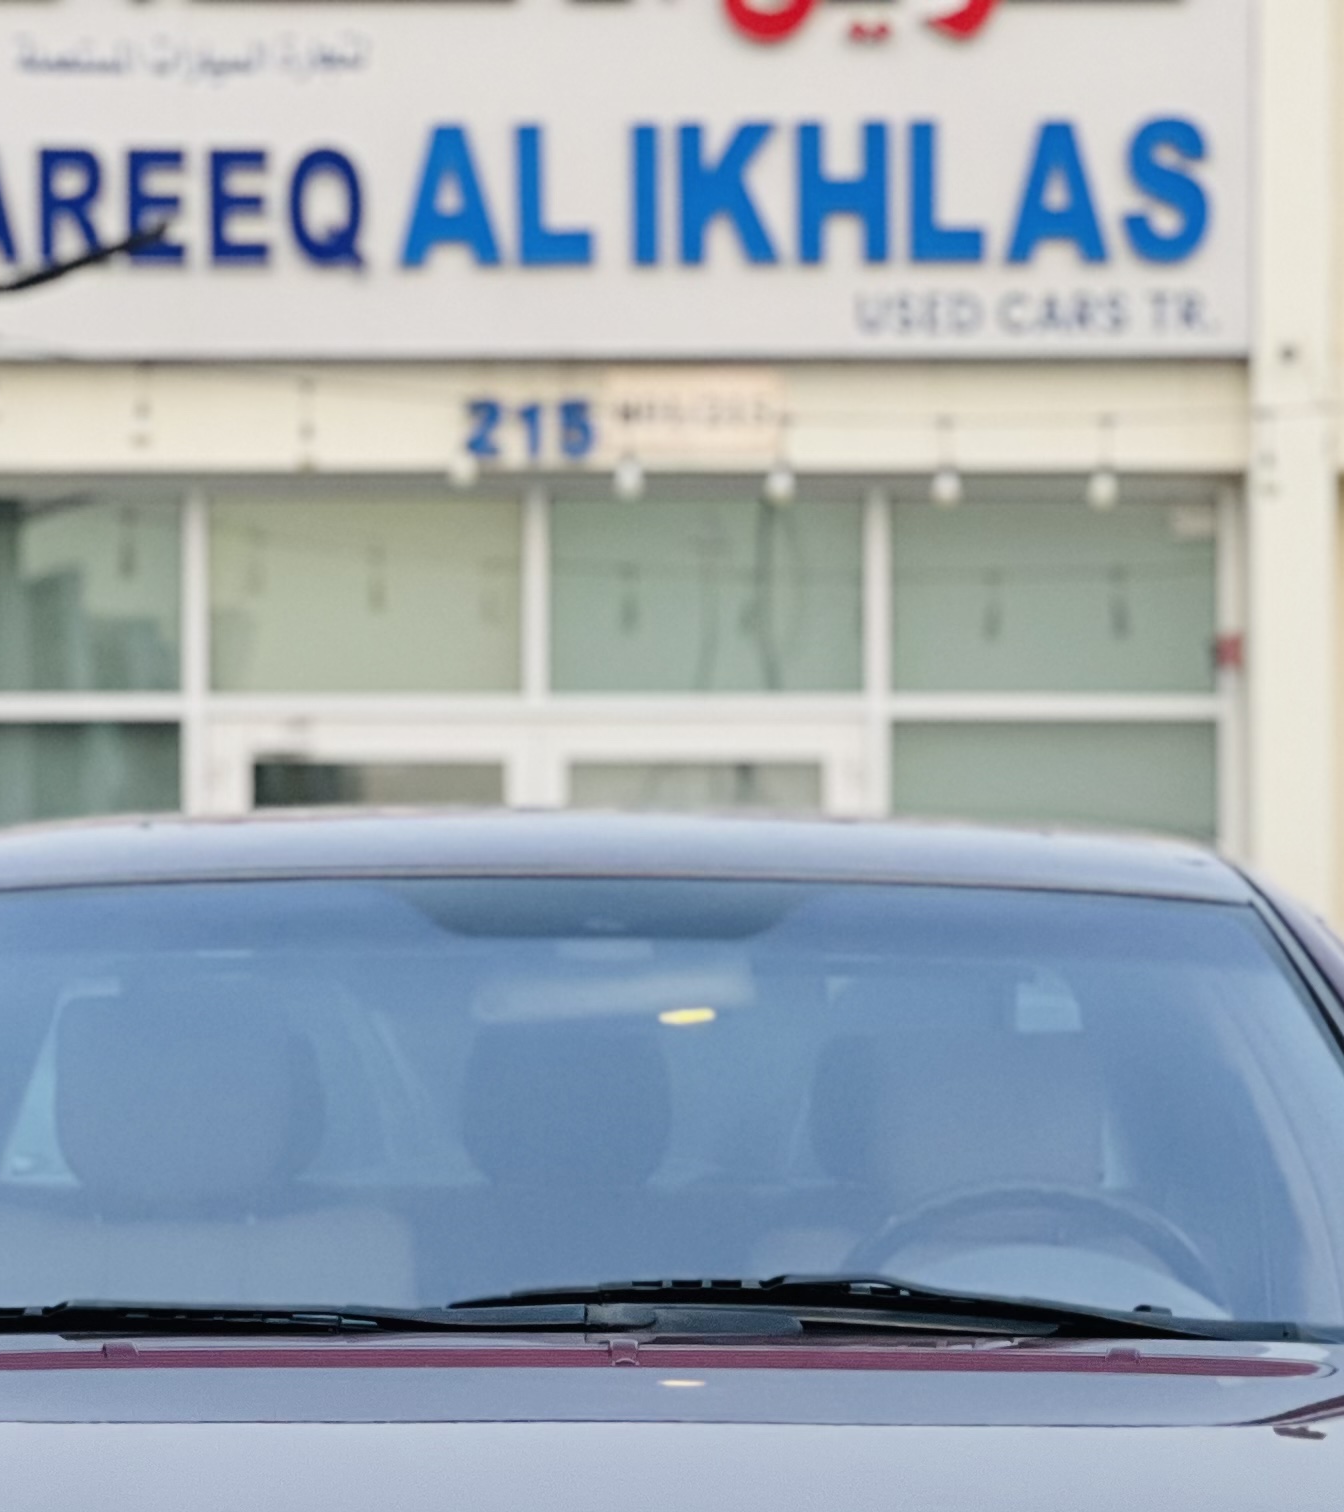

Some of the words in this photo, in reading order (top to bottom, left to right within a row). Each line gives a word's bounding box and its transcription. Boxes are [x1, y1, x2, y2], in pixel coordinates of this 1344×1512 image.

[399, 122, 595, 266] AL
[629, 116, 1211, 266] IKHLAS
[854, 288, 987, 338] USED
[995, 287, 1132, 337] CARS
[465, 399, 595, 459] 215
